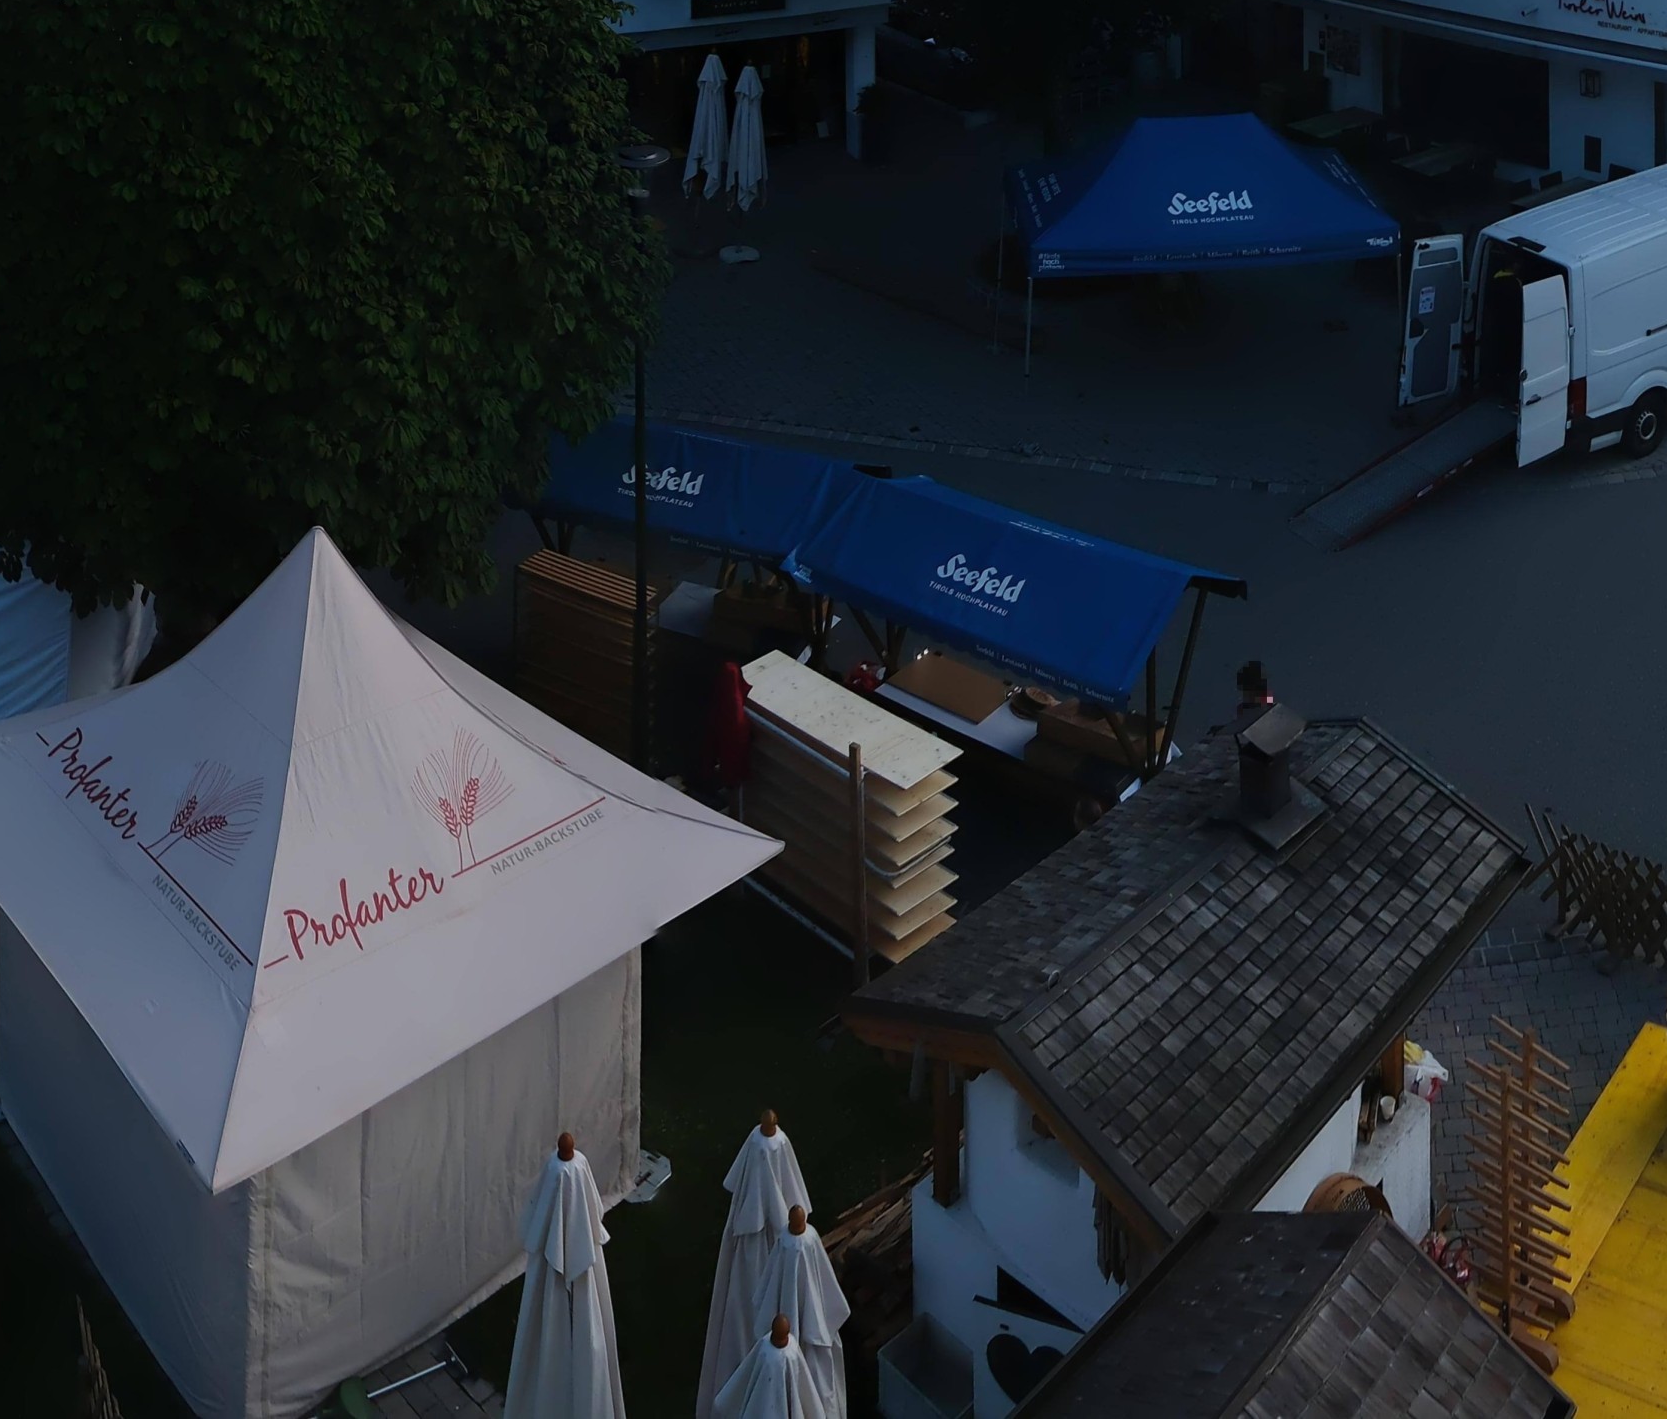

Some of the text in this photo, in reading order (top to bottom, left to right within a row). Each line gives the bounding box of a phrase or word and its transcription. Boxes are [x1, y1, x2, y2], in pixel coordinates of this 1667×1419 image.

[1168, 190, 1253, 215] Seefeld
[929, 581, 1008, 616] TIROLS HOCHPLATEAU
[936, 553, 1026, 602] Seefeld
[61, 728, 137, 841] Profanter
[490, 808, 606, 876] NATUR-BACKSTUBE
[151, 874, 240, 972] NATUR-BACKSTUBE
[283, 867, 443, 962] Profanter
